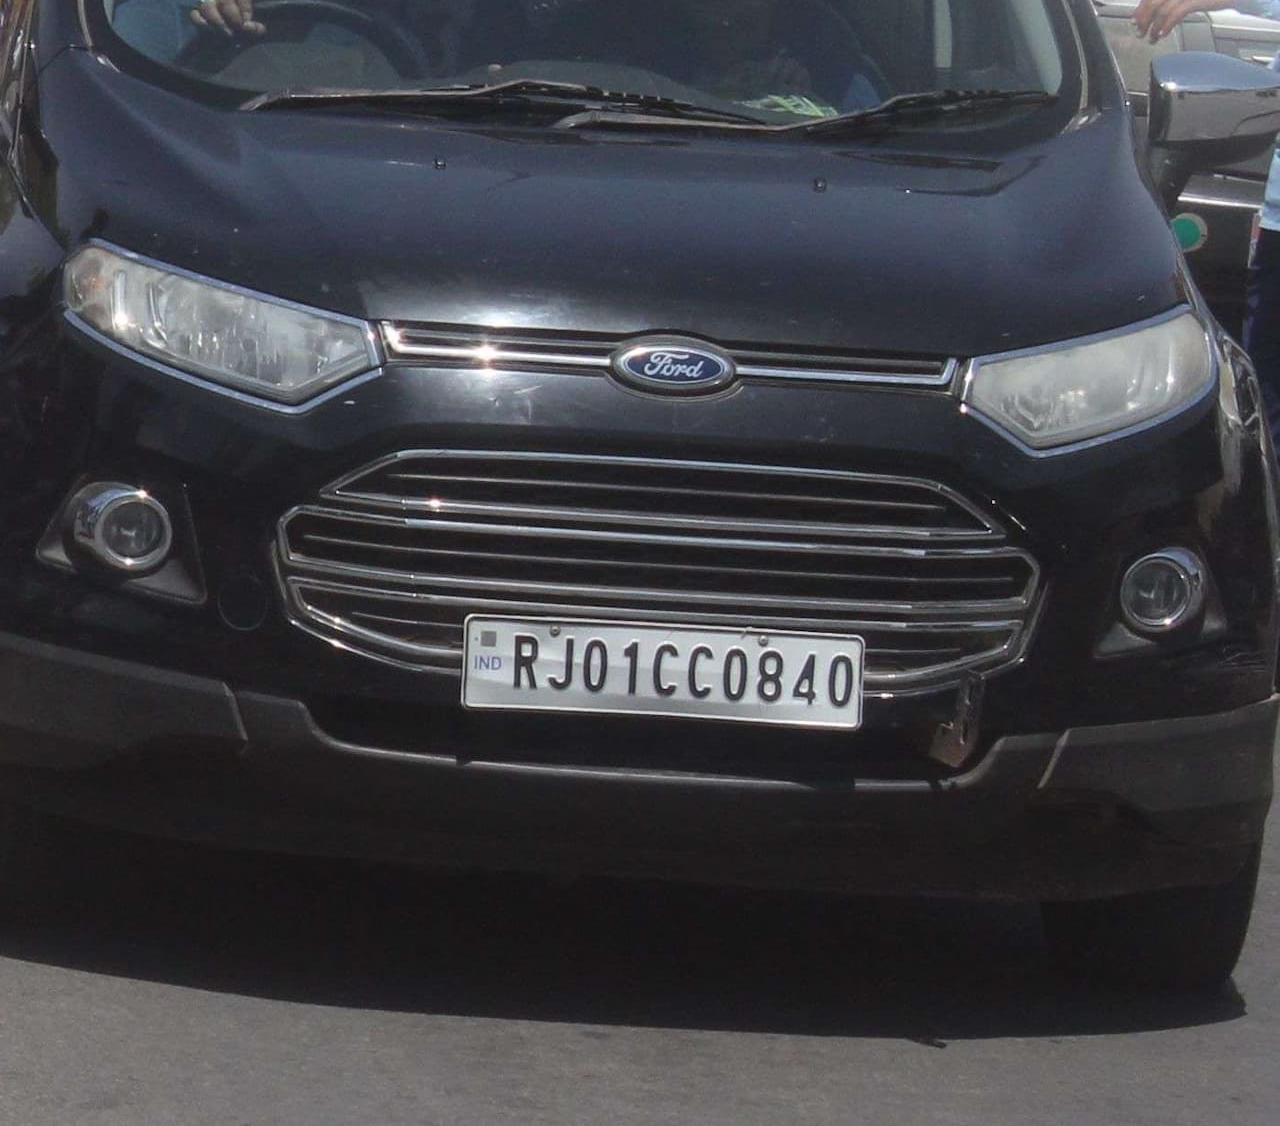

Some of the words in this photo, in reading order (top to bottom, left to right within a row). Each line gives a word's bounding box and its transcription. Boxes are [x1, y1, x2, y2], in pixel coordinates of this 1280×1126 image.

[644, 352, 705, 378] Ford
[473, 655, 502, 671] IND
[512, 633, 854, 708] RJ01CC0840
